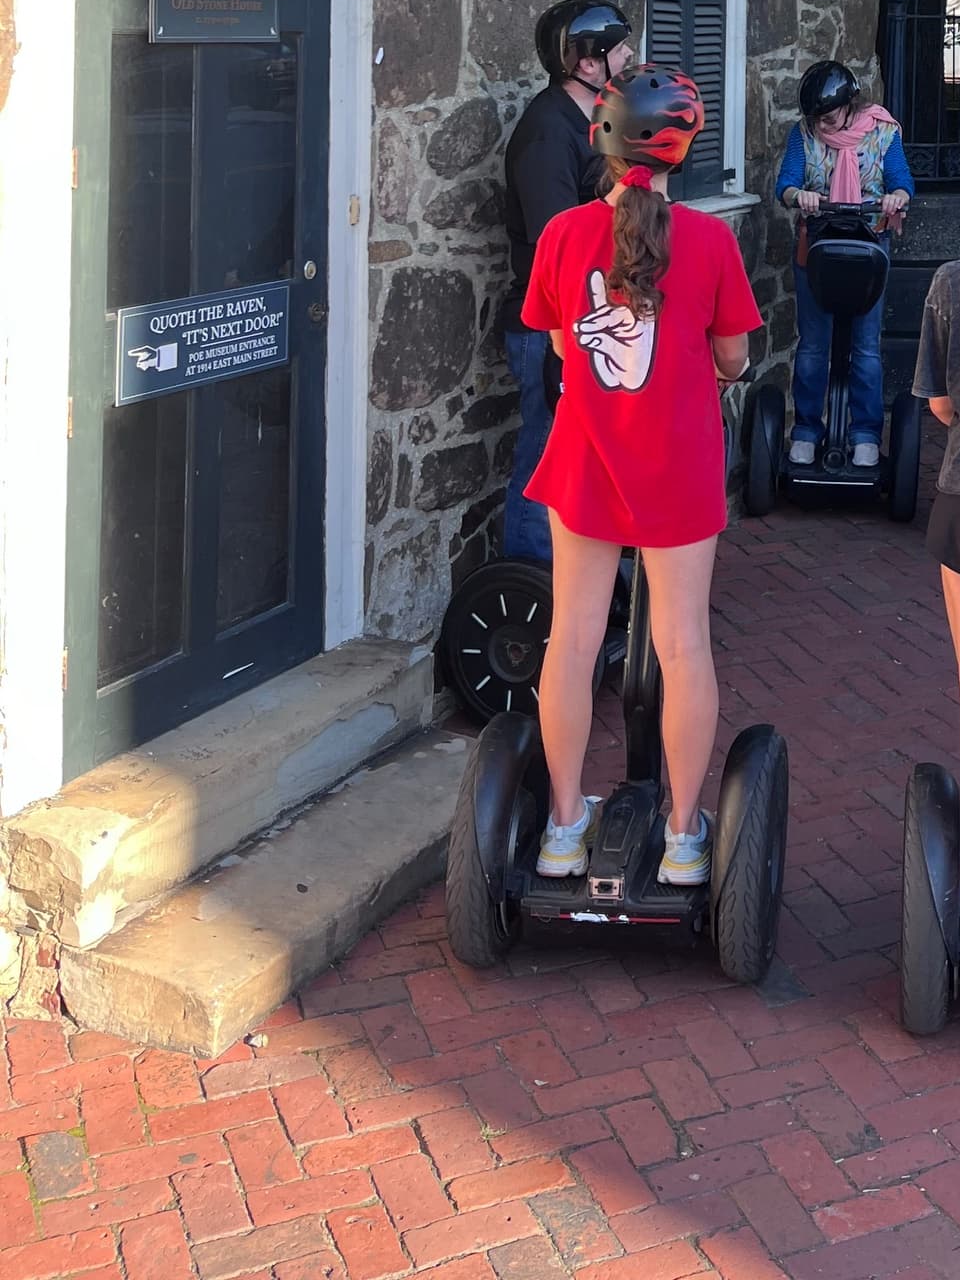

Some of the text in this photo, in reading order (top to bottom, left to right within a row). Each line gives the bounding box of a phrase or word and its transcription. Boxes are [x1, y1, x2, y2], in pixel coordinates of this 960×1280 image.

[150, 297, 266, 333] QUOTH THE RAVEN,
[211, 320, 243, 340] NEXT
[244, 312, 284, 333] DOOR!"
[185, 345, 279, 376] AT 1914 EAST MAIN STREET
[189, 335, 275, 363] POE MUSEUM ENTRANCE
